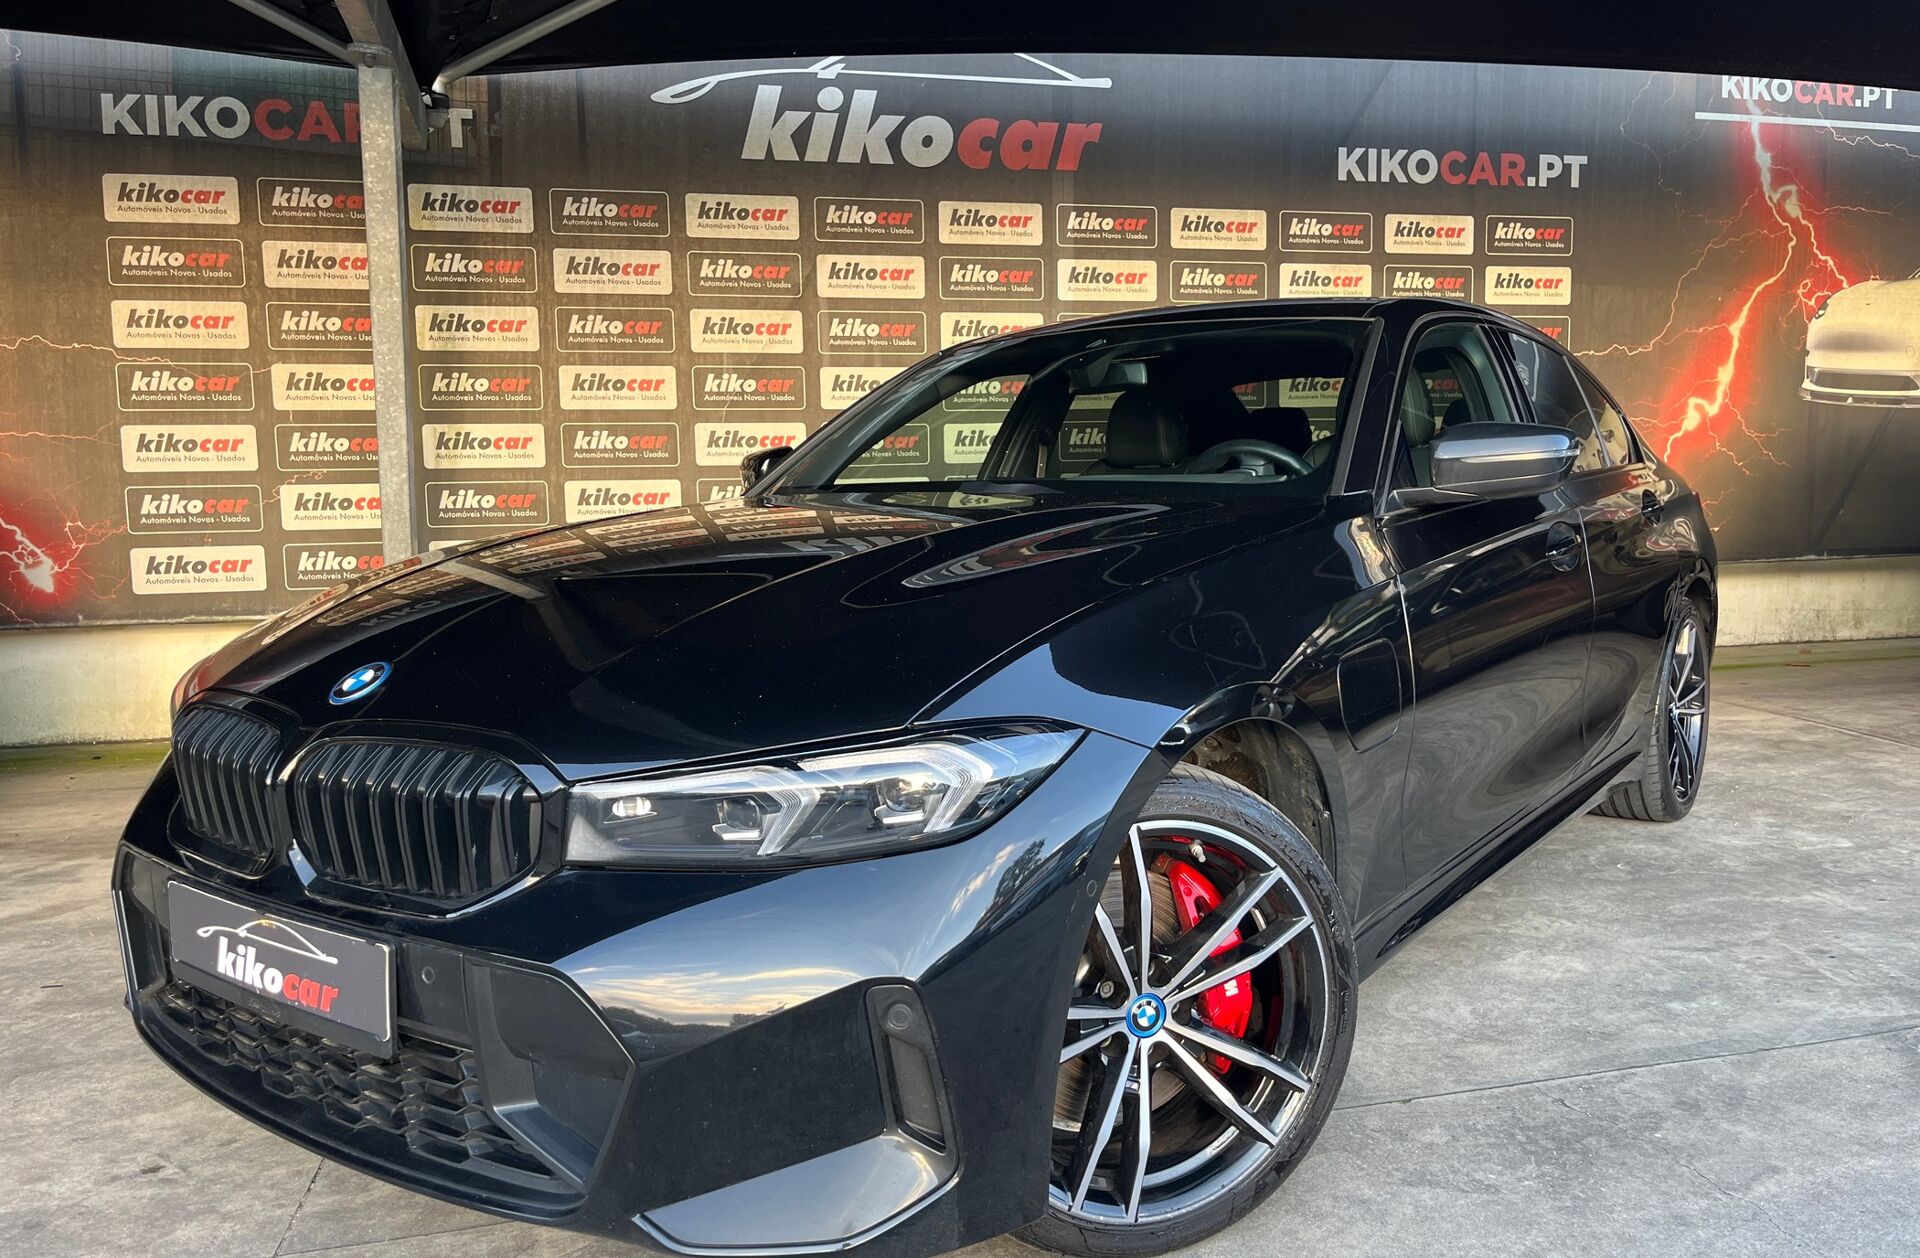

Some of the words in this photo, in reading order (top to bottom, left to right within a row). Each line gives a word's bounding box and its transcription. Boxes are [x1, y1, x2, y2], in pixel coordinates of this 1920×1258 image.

[1721, 75, 1898, 109] KIKOCAR.PT
[741, 84, 1103, 171] kikocar
[1337, 146, 1588, 189] KIKOCAR.PT
[118, 182, 225, 204] kikocar
[272, 186, 362, 209] kikoca
[421, 192, 521, 214] kikocar
[271, 209, 316, 217] Automóveis
[317, 211, 343, 219] Novos
[562, 196, 656, 218] kikocar
[698, 201, 788, 221] kikocar
[826, 205, 912, 224] kikocar
[562, 218, 603, 226] Automóveis
[949, 209, 1032, 228] kikocar
[1067, 212, 1147, 231] kikocar
[1181, 215, 1258, 233] kikocar
[1289, 218, 1363, 236] kikocar
[1394, 221, 1465, 238] kikocar
[1495, 222, 1564, 239] kikocar
[122, 245, 229, 267] kikocar
[277, 249, 367, 270] kikoca
[425, 253, 524, 274] kikocar
[566, 256, 660, 276] kikocar
[202, 269, 231, 277] Usados
[425, 275, 468, 283] Automóveis
[700, 259, 790, 279] kikocar
[828, 262, 915, 281] kikocar
[950, 264, 1033, 284] kikocar
[1068, 266, 1147, 284] kikocar
[1180, 268, 1257, 287] kikocar
[1289, 270, 1363, 287] kikocar
[1393, 272, 1464, 289] kikocar
[1494, 273, 1563, 289] kikocar
[127, 309, 235, 329] kikocar
[281, 311, 371, 333] kikoca
[429, 313, 527, 332] kikocar
[568, 314, 662, 334] kikocar
[702, 317, 792, 336] kikocar
[829, 318, 915, 338] kikocar
[327, 333, 352, 341] Novos
[131, 370, 239, 392] kikocar
[286, 372, 374, 392] kikoca
[432, 372, 530, 392] kikocar
[572, 373, 665, 392] kikocar
[705, 373, 793, 393] kikocar
[136, 433, 244, 452] kikocar
[290, 432, 377, 453] kikoca
[435, 431, 533, 450] kikocar
[574, 430, 667, 450] kikocar
[707, 430, 796, 448] kikocar
[141, 493, 248, 514] kikocar
[294, 492, 380, 511] kikoca
[439, 489, 536, 509] kikocar
[577, 488, 670, 506] kikocar
[140, 516, 187, 524] Automóveis
[146, 555, 252, 575] kikocar
[298, 551, 383, 571] kikoca
[217, 935, 339, 1013] kikocar
